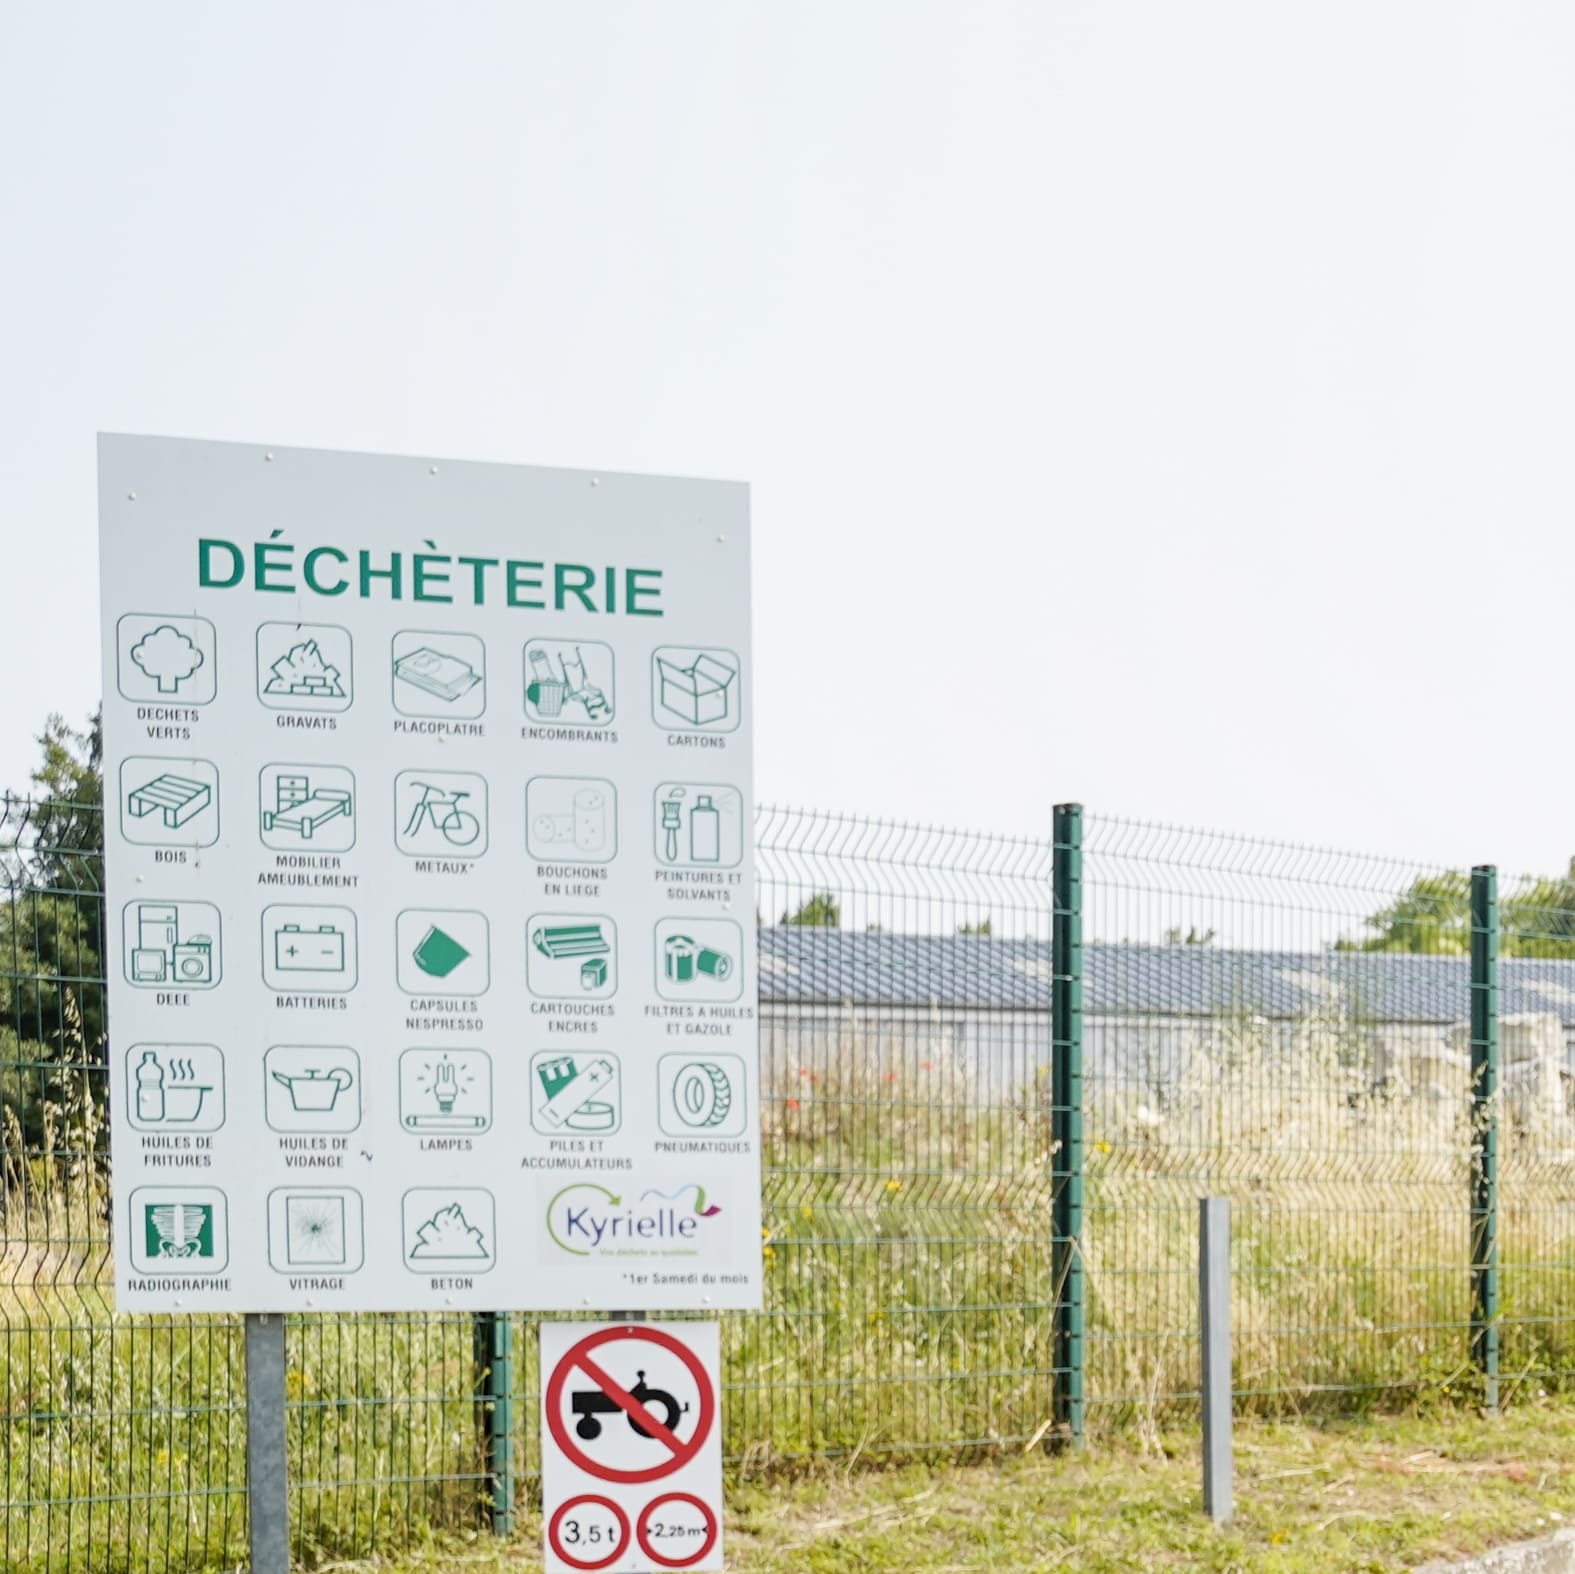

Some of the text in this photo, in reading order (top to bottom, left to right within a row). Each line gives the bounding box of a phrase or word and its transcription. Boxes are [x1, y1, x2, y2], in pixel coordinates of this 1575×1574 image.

[198, 532, 664, 616] DÉCHÈTERIE
[136, 707, 200, 722] DECHETS
[276, 715, 337, 730] GRAVATS
[393, 719, 484, 736] PLACOPLATRE
[146, 726, 191, 740] VERTS
[521, 727, 618, 742] ENCOMBRANTS
[667, 734, 728, 749] CARTONS
[154, 850, 187, 863] BOIS
[275, 854, 341, 869] MOBILIER
[257, 872, 359, 887] AMEUBLEMENT
[535, 865, 609, 880] BOUCHONS
[654, 869, 743, 884] PEINTURES ET
[544, 883, 600, 897] EN LIEGE
[667, 887, 734, 903] SOLVANTS
[156, 993, 188, 1006] DEEE
[276, 995, 347, 1010] BATTERIES
[409, 999, 478, 1012] CAPSULES
[528, 1002, 615, 1018] CARTOUCHES
[644, 1004, 754, 1019] FILTRES A HUILES
[405, 1017, 484, 1031] NESPRESSO
[548, 1020, 598, 1033] ENCRES
[666, 1022, 732, 1036] ET GAZOLE
[141, 1136, 212, 1149] HUILES DE
[278, 1137, 348, 1151] HUILES DE
[419, 1138, 473, 1151] LAMPES
[549, 1140, 605, 1152] PILES ET
[654, 1140, 754, 1153] PNEUMATIQUES
[144, 1154, 212, 1167] FRITURES
[285, 1155, 342, 1168] VIDANGE
[521, 1156, 633, 1170] ACCUMULATEURS
[566, 1207, 698, 1247] Kyrielle
[127, 1278, 230, 1292] RADIOGRAPHIE
[289, 1278, 344, 1291] VITRAGE
[430, 1277, 474, 1290] BETON
[564, 1520, 601, 1546] 3,5
